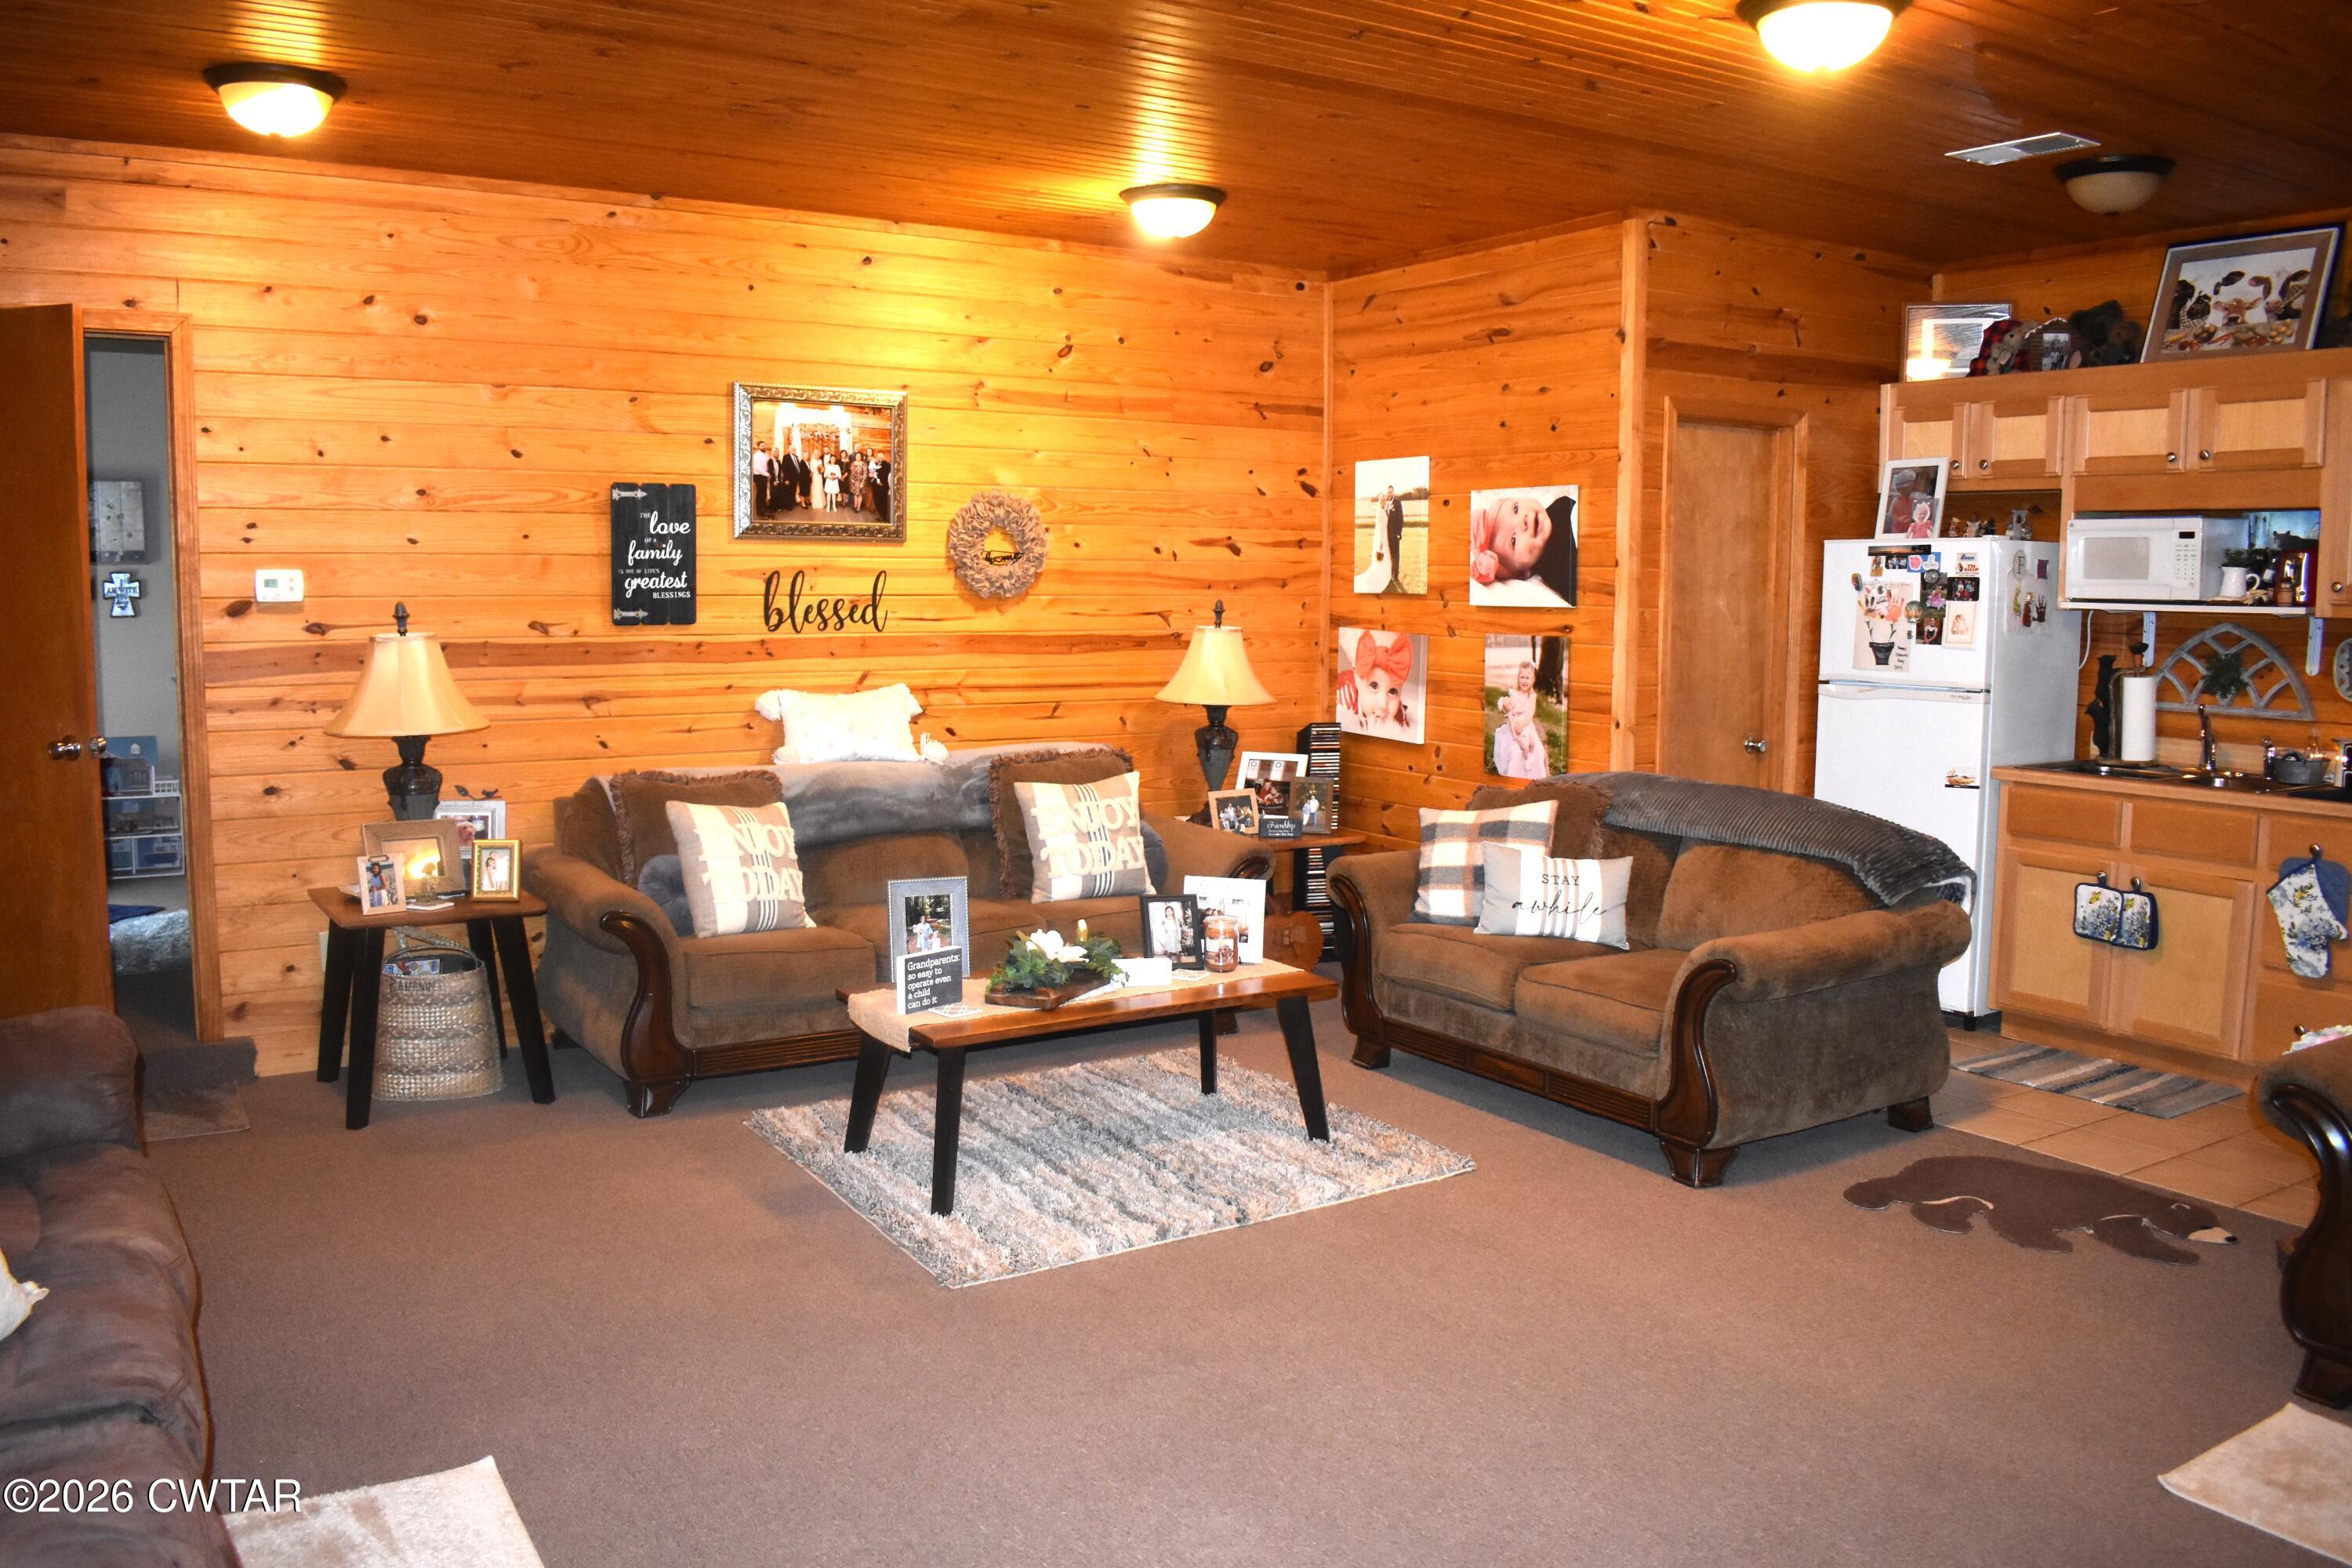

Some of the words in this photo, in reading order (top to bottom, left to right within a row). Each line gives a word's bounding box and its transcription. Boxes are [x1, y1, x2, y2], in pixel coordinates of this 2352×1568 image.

[649, 510, 690, 534] love
[628, 539, 683, 566] family
[2017, 556, 2025, 574] F
[624, 572, 688, 597] greatest
[764, 570, 888, 633] blessed
[1030, 797, 1138, 840] ENJOY
[693, 823, 798, 862] ENJOY
[1040, 836, 1145, 879] TODAY
[702, 866, 805, 903] TODAY
[1541, 874, 1580, 886] STAY
[1512, 890, 1607, 924] awhile
[908, 953, 960, 971] Grandparents:
[917, 969, 933, 979] easy
[908, 979, 934, 991] operate
[935, 975, 951, 984] even
[913, 988, 931, 998] child
[922, 997, 931, 1006] do
